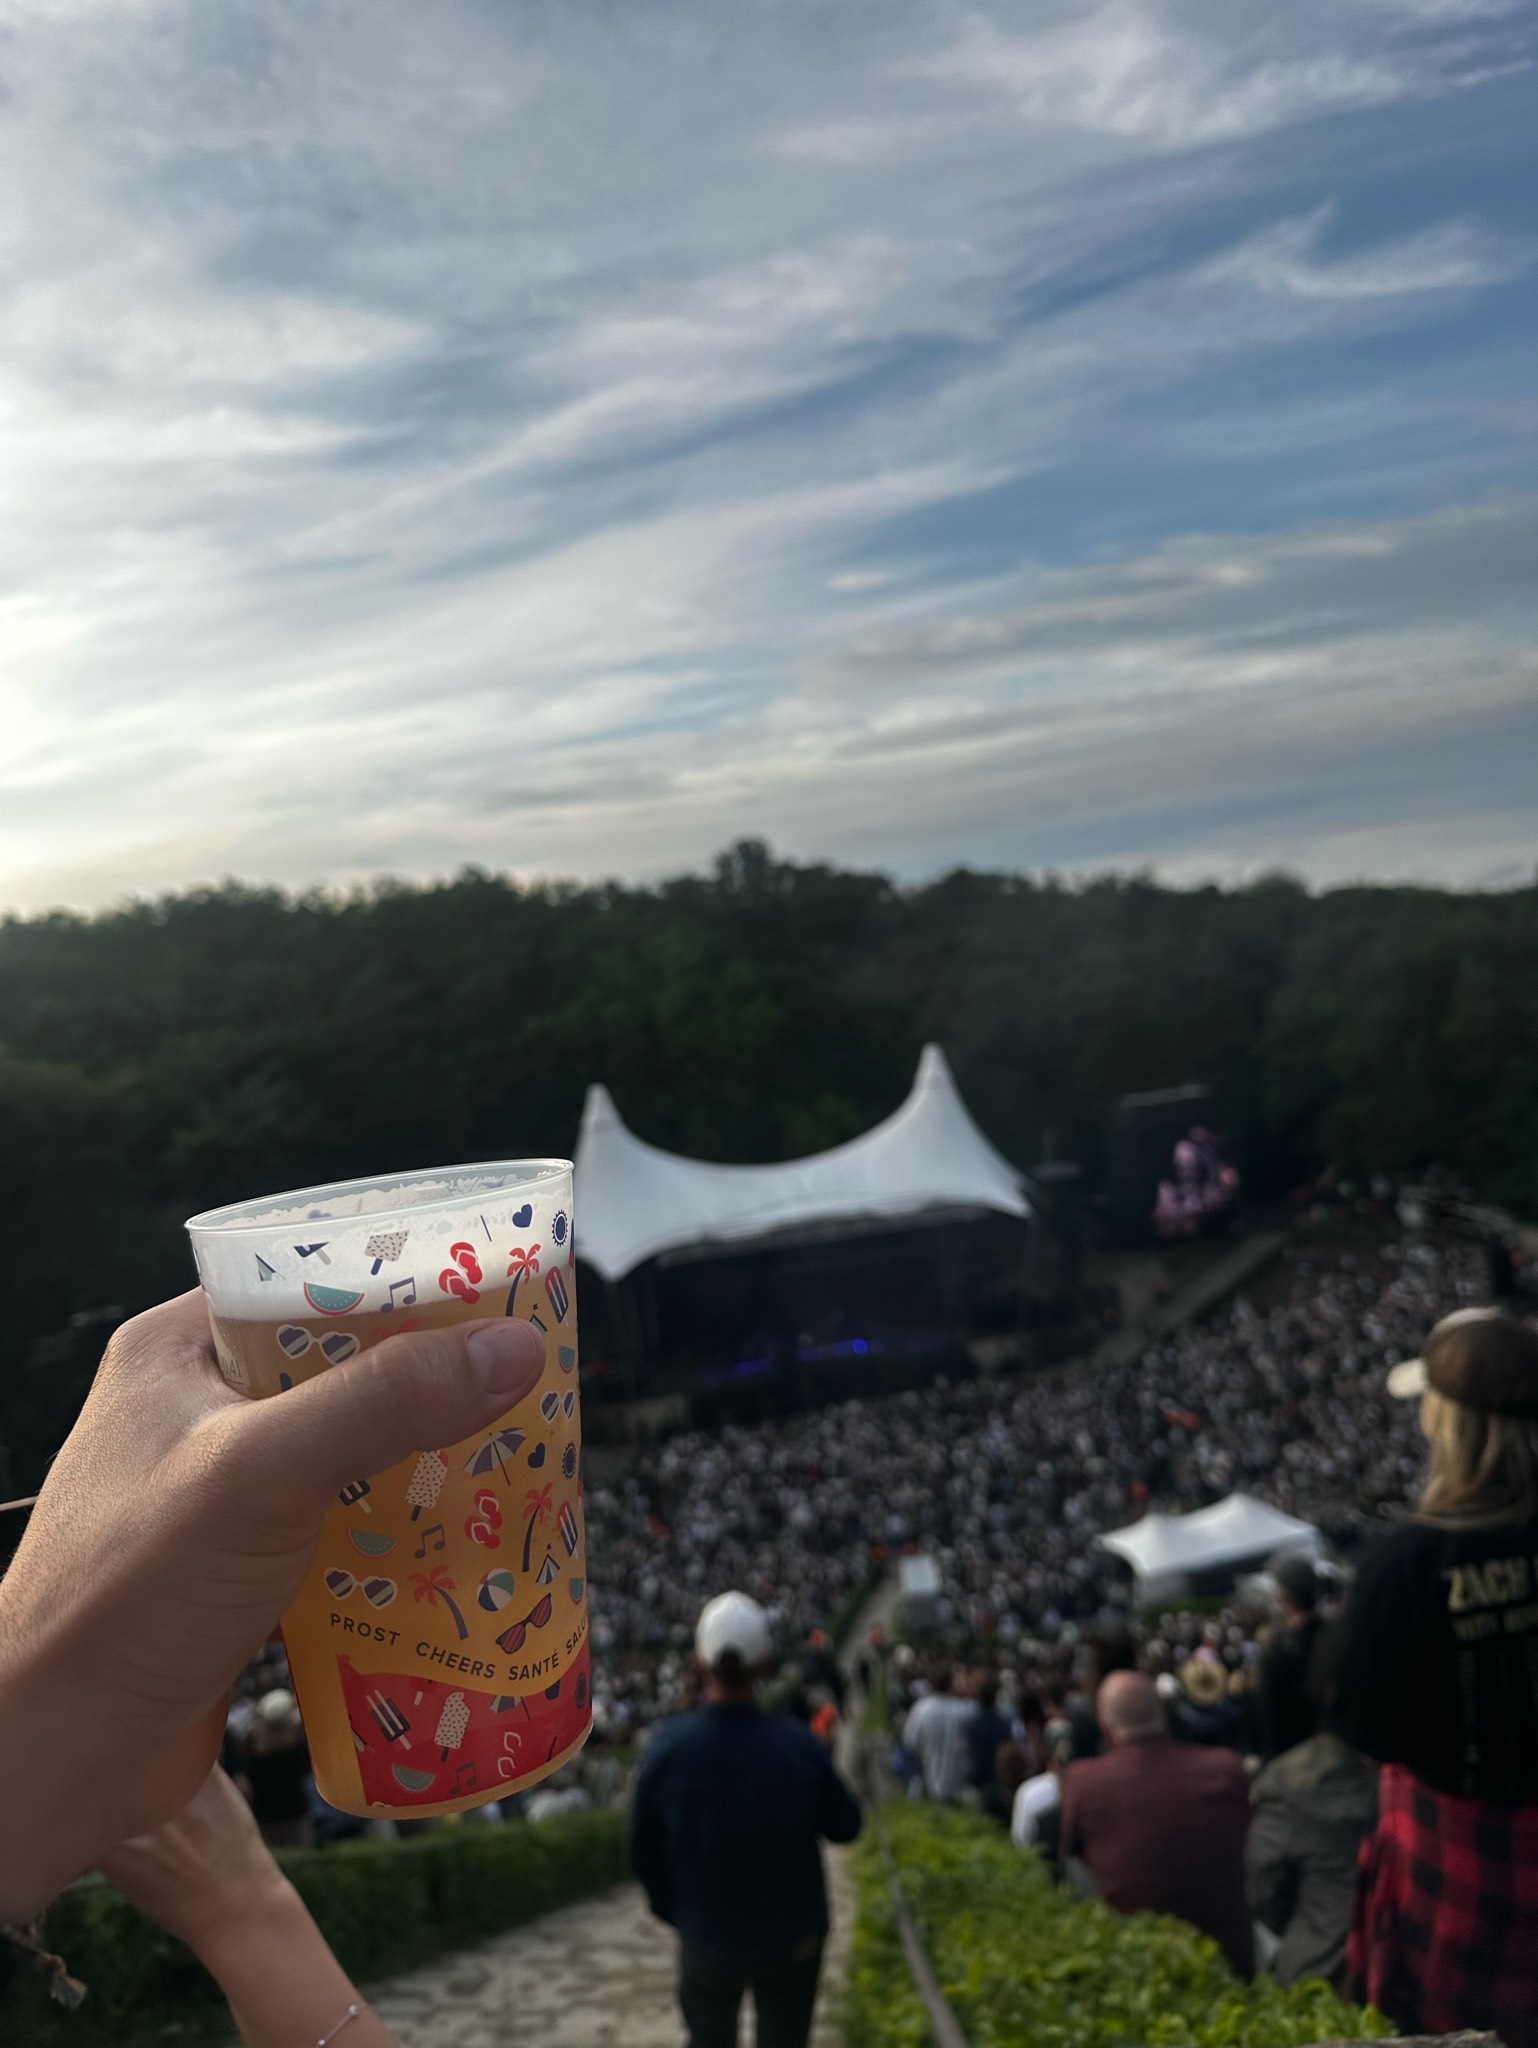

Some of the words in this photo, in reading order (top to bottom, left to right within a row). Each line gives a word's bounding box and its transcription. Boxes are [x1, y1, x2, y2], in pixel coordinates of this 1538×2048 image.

[1441, 1555, 1530, 1613] ZACH
[330, 1612, 401, 1646] PROST
[415, 1641, 496, 1679] CHEERS
[507, 1649, 559, 1681] SANTÉ
[565, 1610, 588, 1655] SALU
